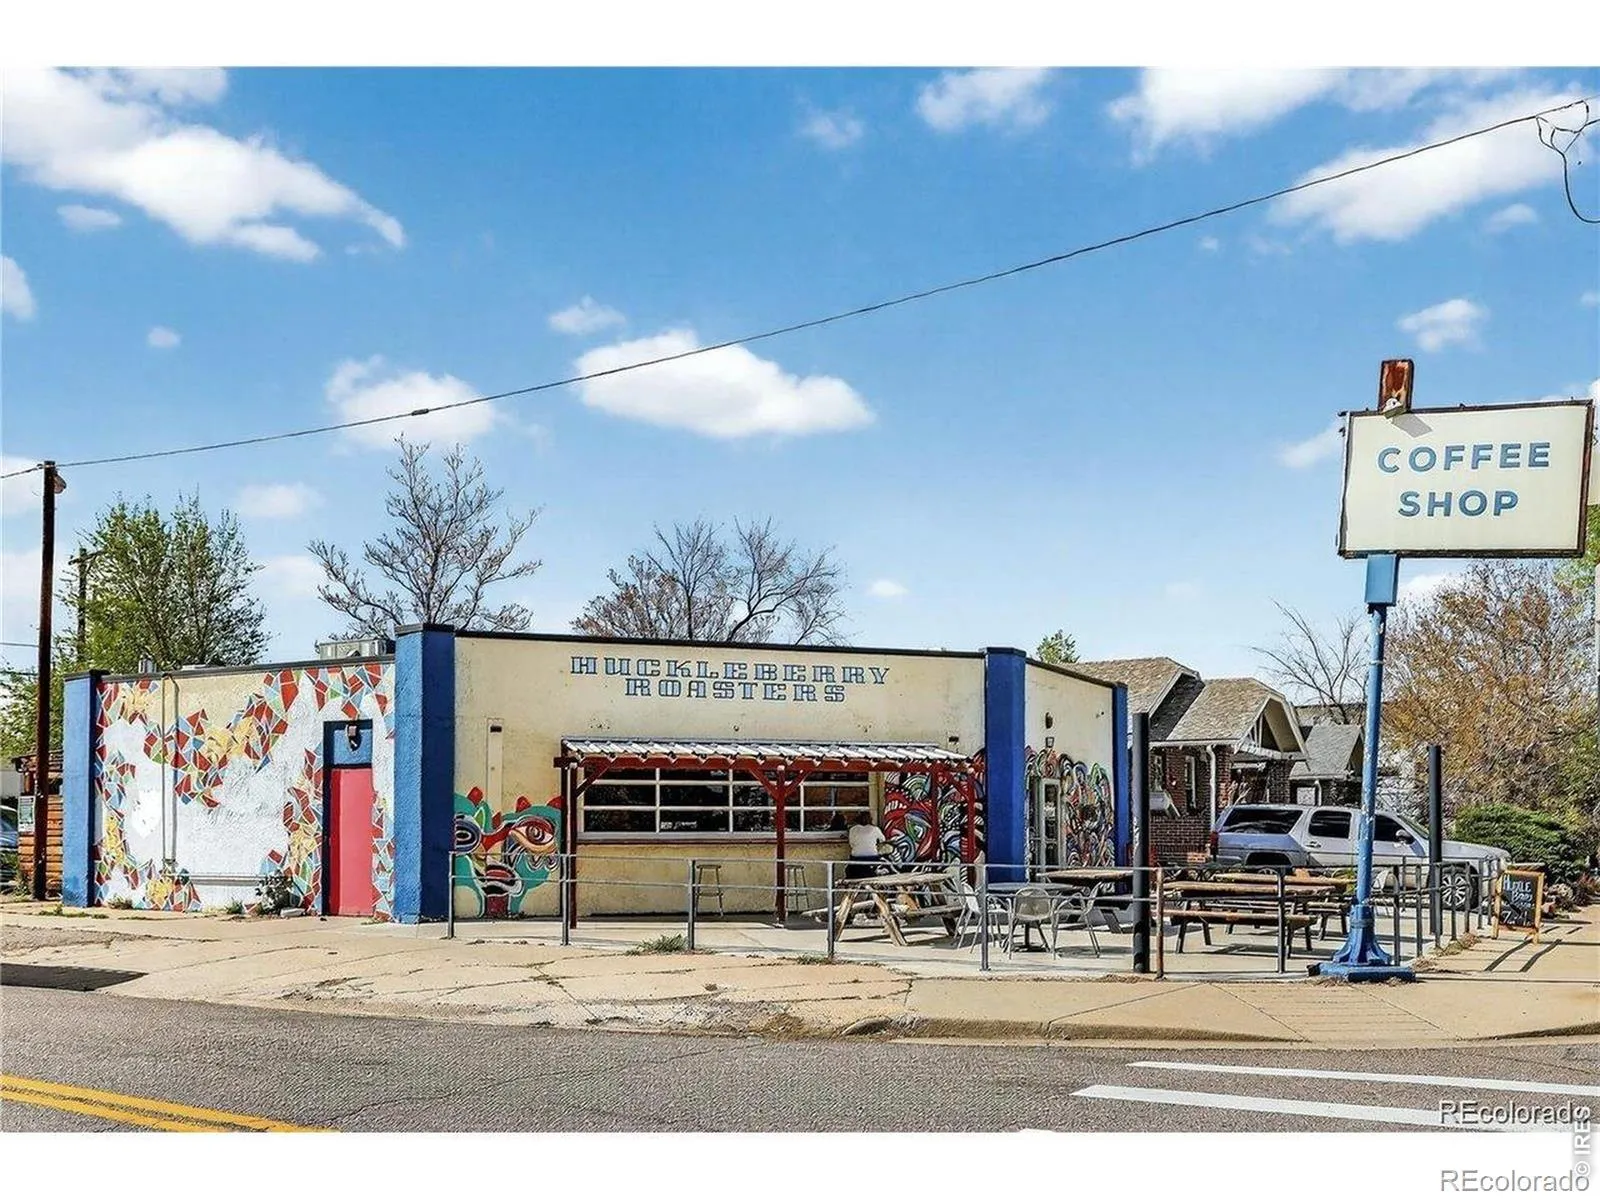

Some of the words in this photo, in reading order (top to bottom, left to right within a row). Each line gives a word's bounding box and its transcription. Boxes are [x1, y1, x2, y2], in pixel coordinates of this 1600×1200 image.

[1377, 442, 1551, 473] COFFEE
[1398, 490, 1519, 517] SHOP
[570, 656, 890, 685] HUCKLEBERRY
[625, 678, 846, 702] ROASTERS
